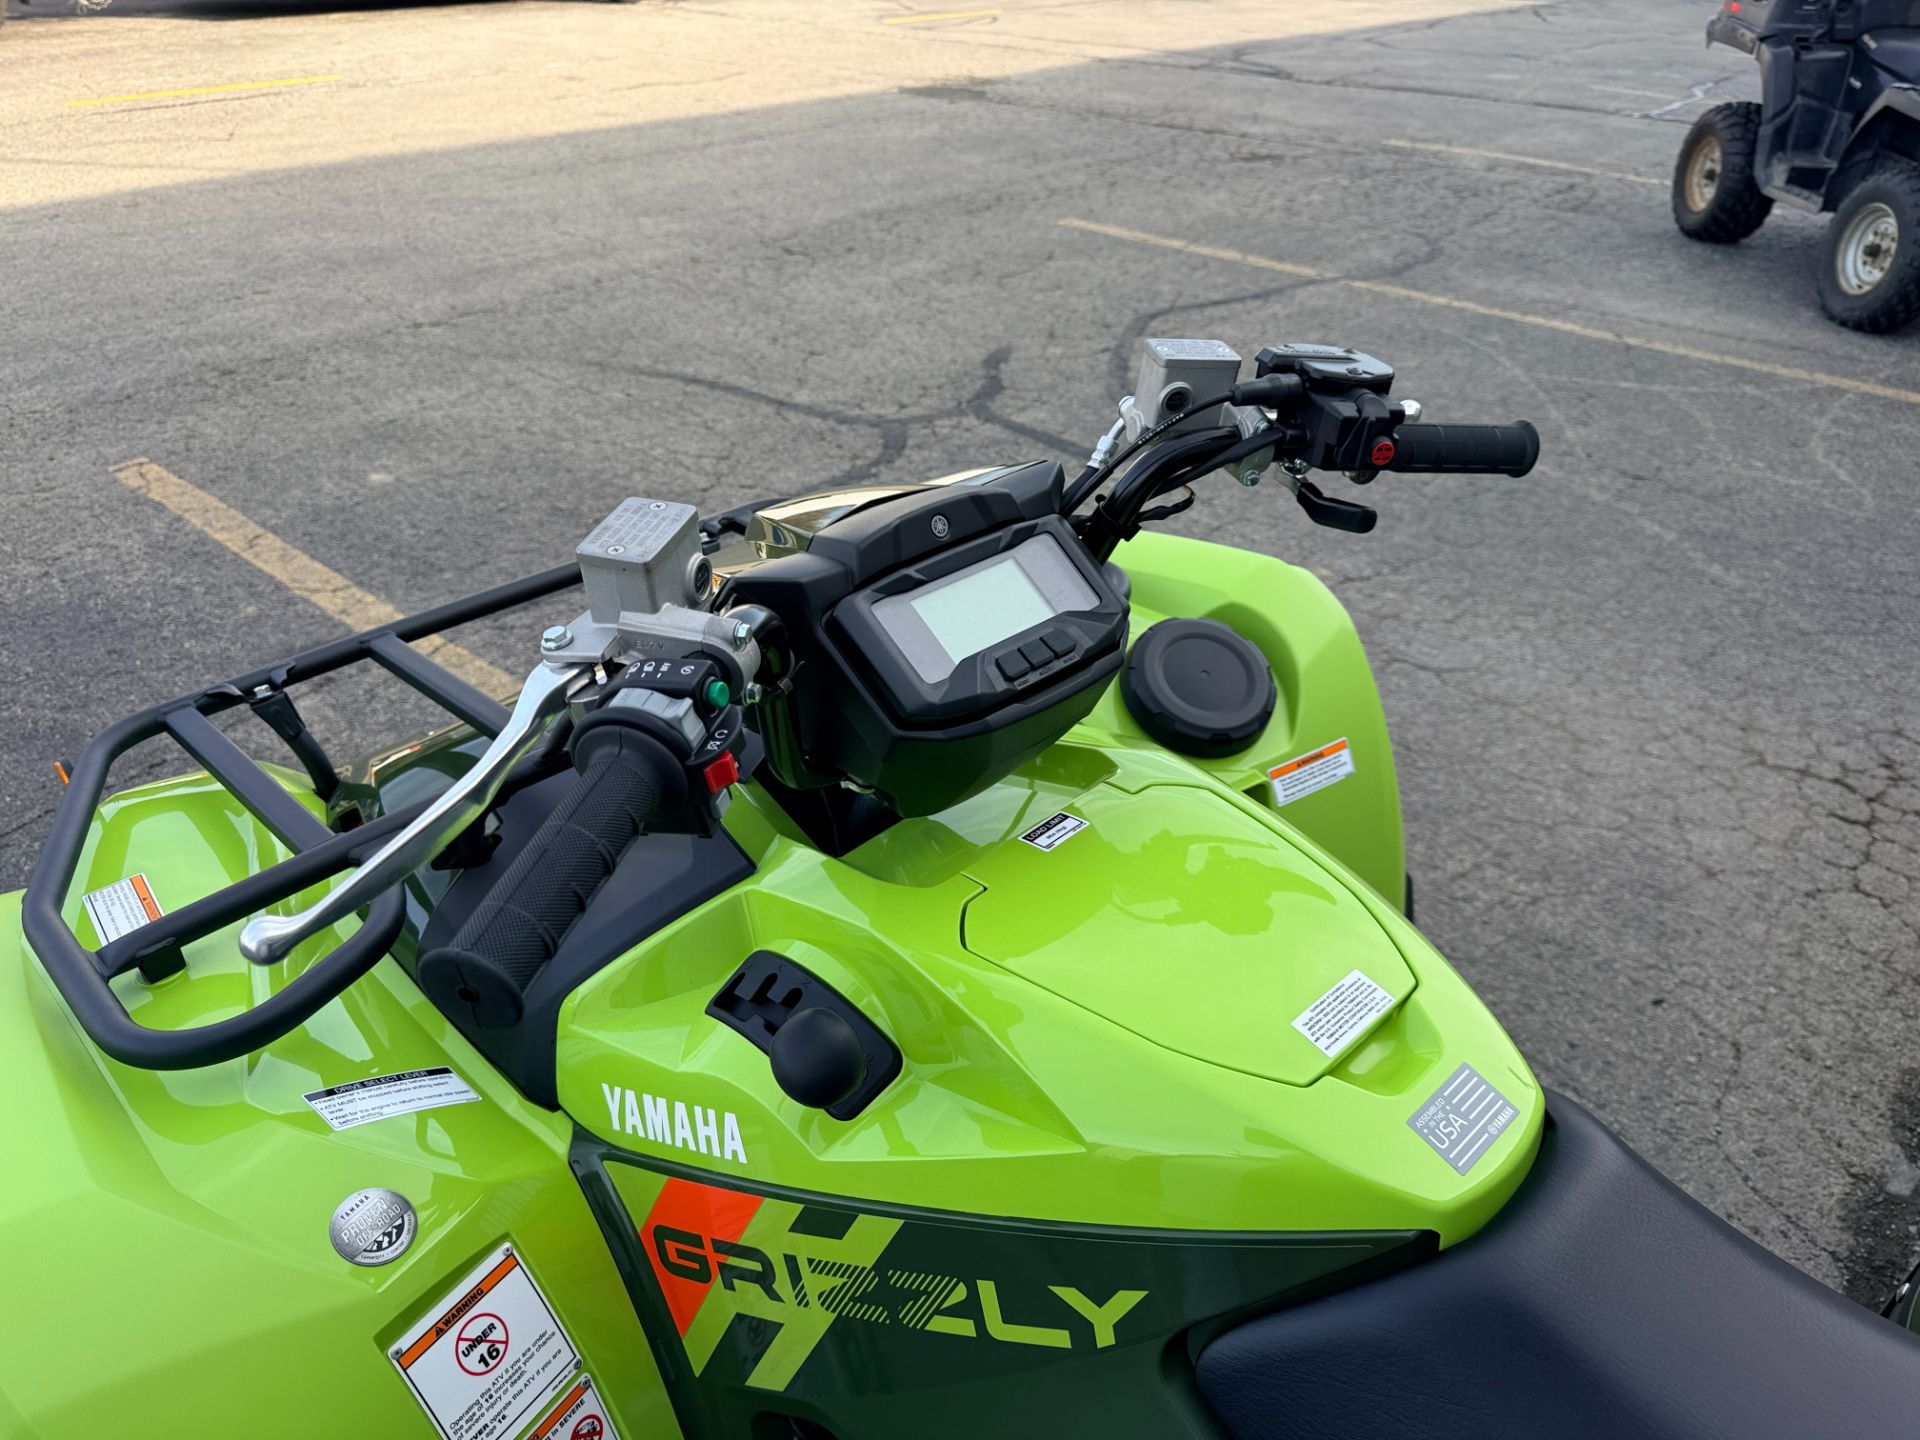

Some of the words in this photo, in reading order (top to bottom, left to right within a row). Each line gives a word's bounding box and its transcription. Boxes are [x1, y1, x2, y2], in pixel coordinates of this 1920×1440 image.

[1026, 826, 1048, 840] LOAD
[1045, 814, 1065, 827] LIMIT
[334, 1083, 362, 1093] DRIVE
[364, 1075, 398, 1086] SELECT
[399, 1071, 428, 1080] LEVER
[602, 1083, 748, 1164] YAMAHA
[1415, 1097, 1444, 1128] ASSEMBLED
[1428, 1119, 1436, 1127] IN
[1433, 1110, 1445, 1121] THE
[1428, 1113, 1467, 1150] USA
[1491, 1106, 1515, 1129] YAMAHA
[340, 1195, 370, 1220] YAMAHA
[341, 1197, 388, 1243] PROVEN
[356, 1203, 401, 1246] OFF-ROAD
[652, 1224, 1149, 1348] GRIZZLY
[442, 1287, 484, 1326] WARNING
[461, 1322, 497, 1358] UNDER
[478, 1343, 500, 1368] 16
[449, 1398, 480, 1429] Operating
[479, 1387, 491, 1399] this
[491, 1372, 503, 1387] ATV
[509, 1357, 521, 1370] you
[521, 1346, 531, 1357] are
[531, 1329, 547, 1347] under
[452, 1424, 463, 1435] the
[464, 1411, 476, 1424] age
[476, 1402, 483, 1411] of
[484, 1393, 493, 1403] 16
[493, 1365, 522, 1394] increases
[522, 1351, 534, 1366] your
[535, 1331, 555, 1352] chance
[489, 1400, 511, 1423] operate
[511, 1388, 523, 1400] this
[523, 1374, 534, 1389] ATV
[535, 1368, 540, 1376] if
[540, 1359, 551, 1371] you
[551, 1348, 561, 1359] are
[464, 1412, 485, 1433] severe
[485, 1394, 501, 1412] injury
[502, 1386, 508, 1395] or
[509, 1369, 526, 1387] death.
[551, 1428, 559, 1437] in
[559, 1398, 585, 1428] SEVERE
[485, 1425, 496, 1437] age
